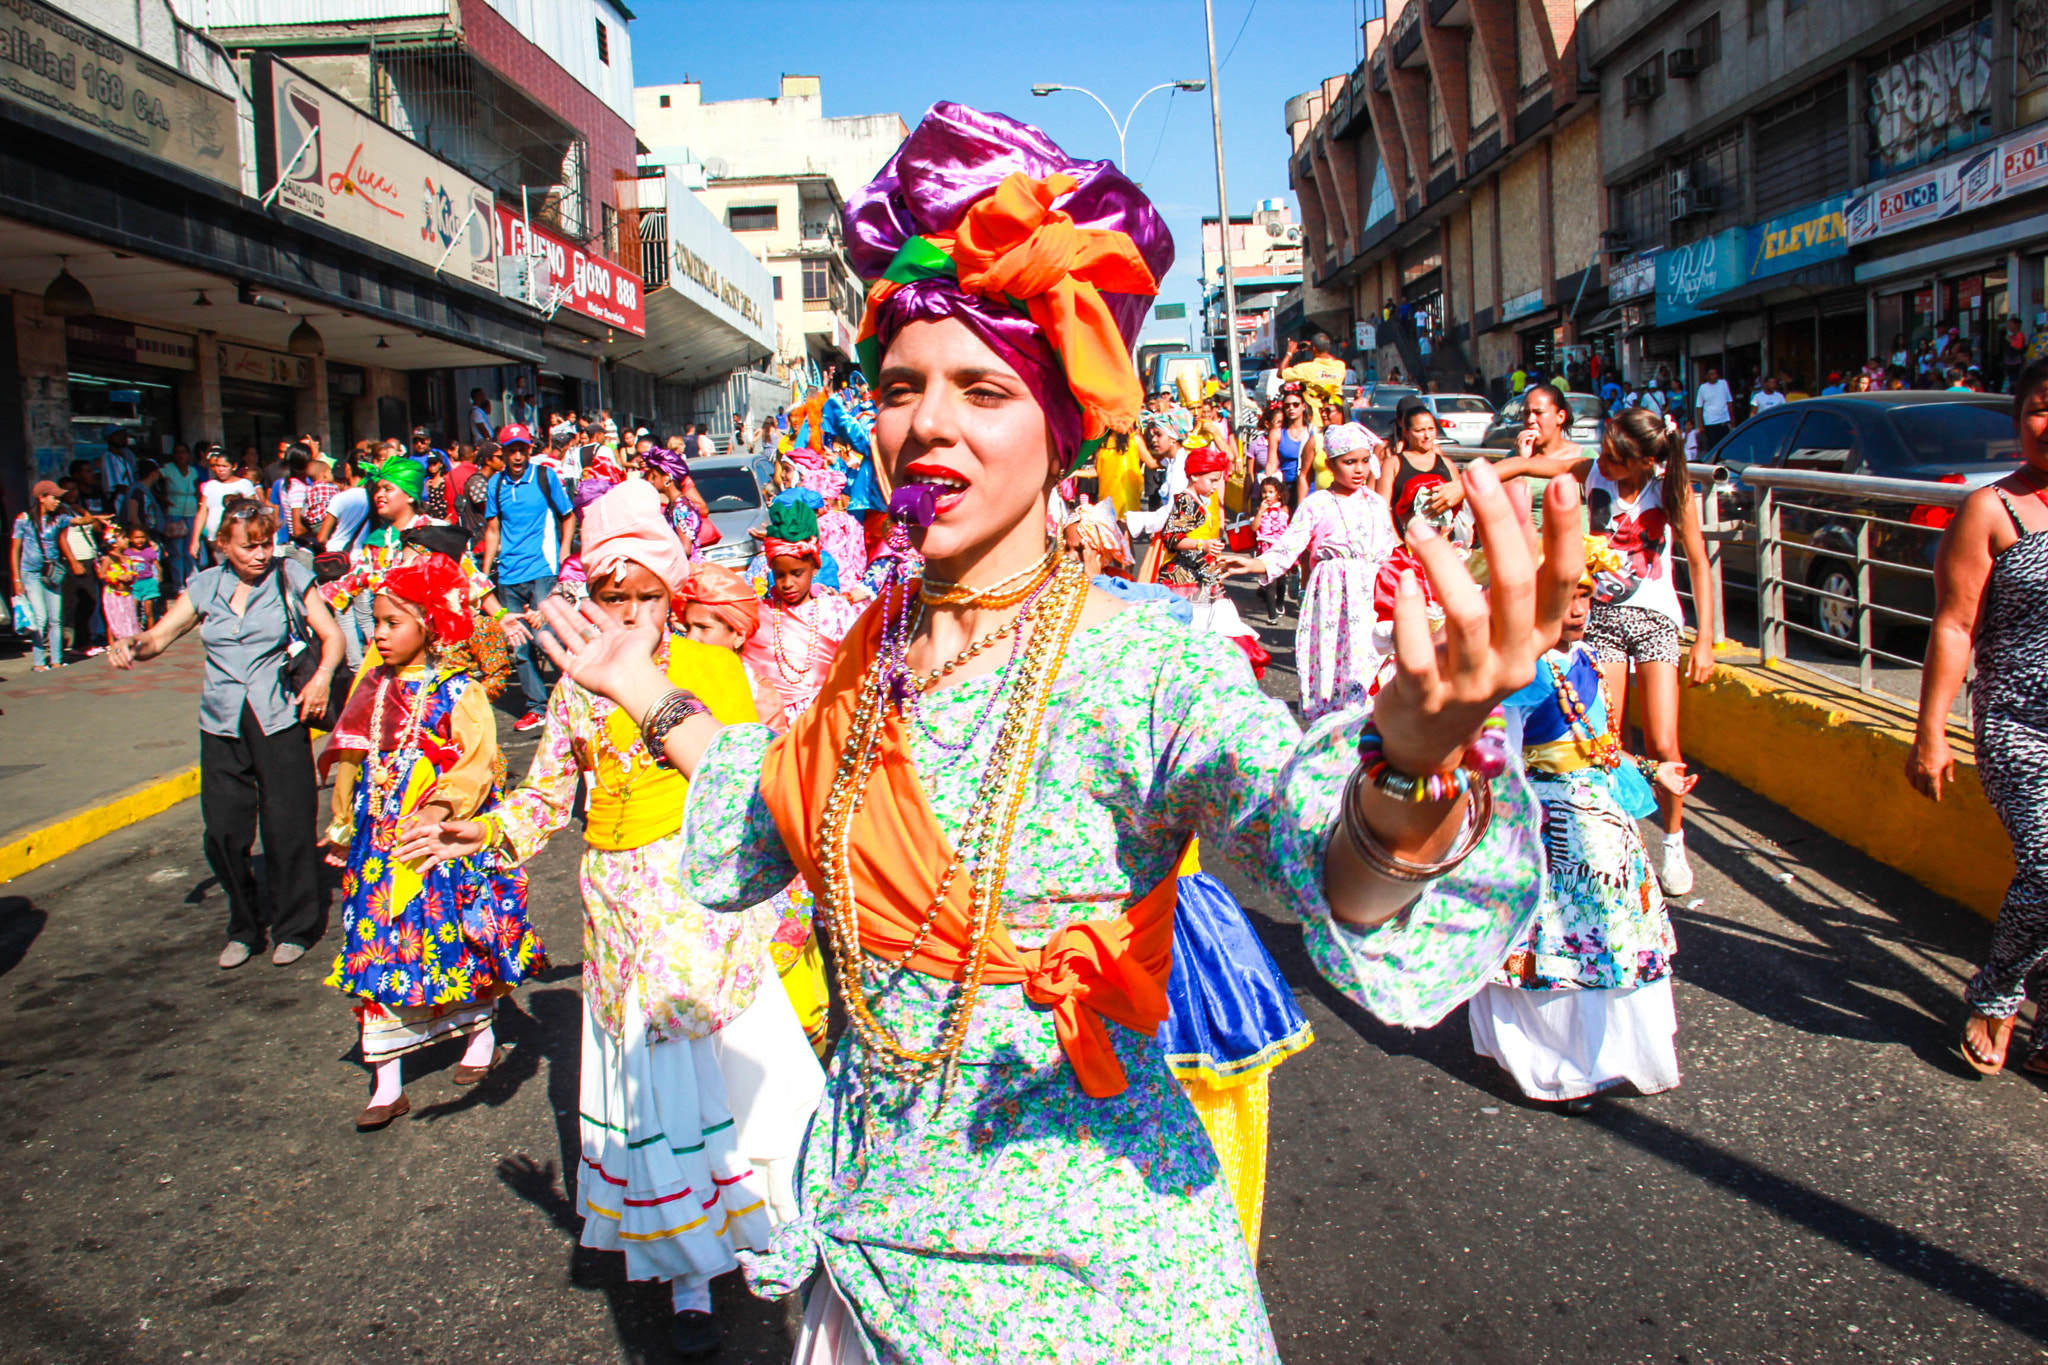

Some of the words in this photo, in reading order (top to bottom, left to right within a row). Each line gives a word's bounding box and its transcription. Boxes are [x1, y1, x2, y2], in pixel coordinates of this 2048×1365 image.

[0, 0, 124, 65] upermercado
[82, 62, 124, 111] 168
[133, 89, 170, 132] C.A.
[282, 178, 325, 209] SAUSALITO
[1765, 211, 1845, 260] ELEVEN
[616, 276, 637, 311] 888
